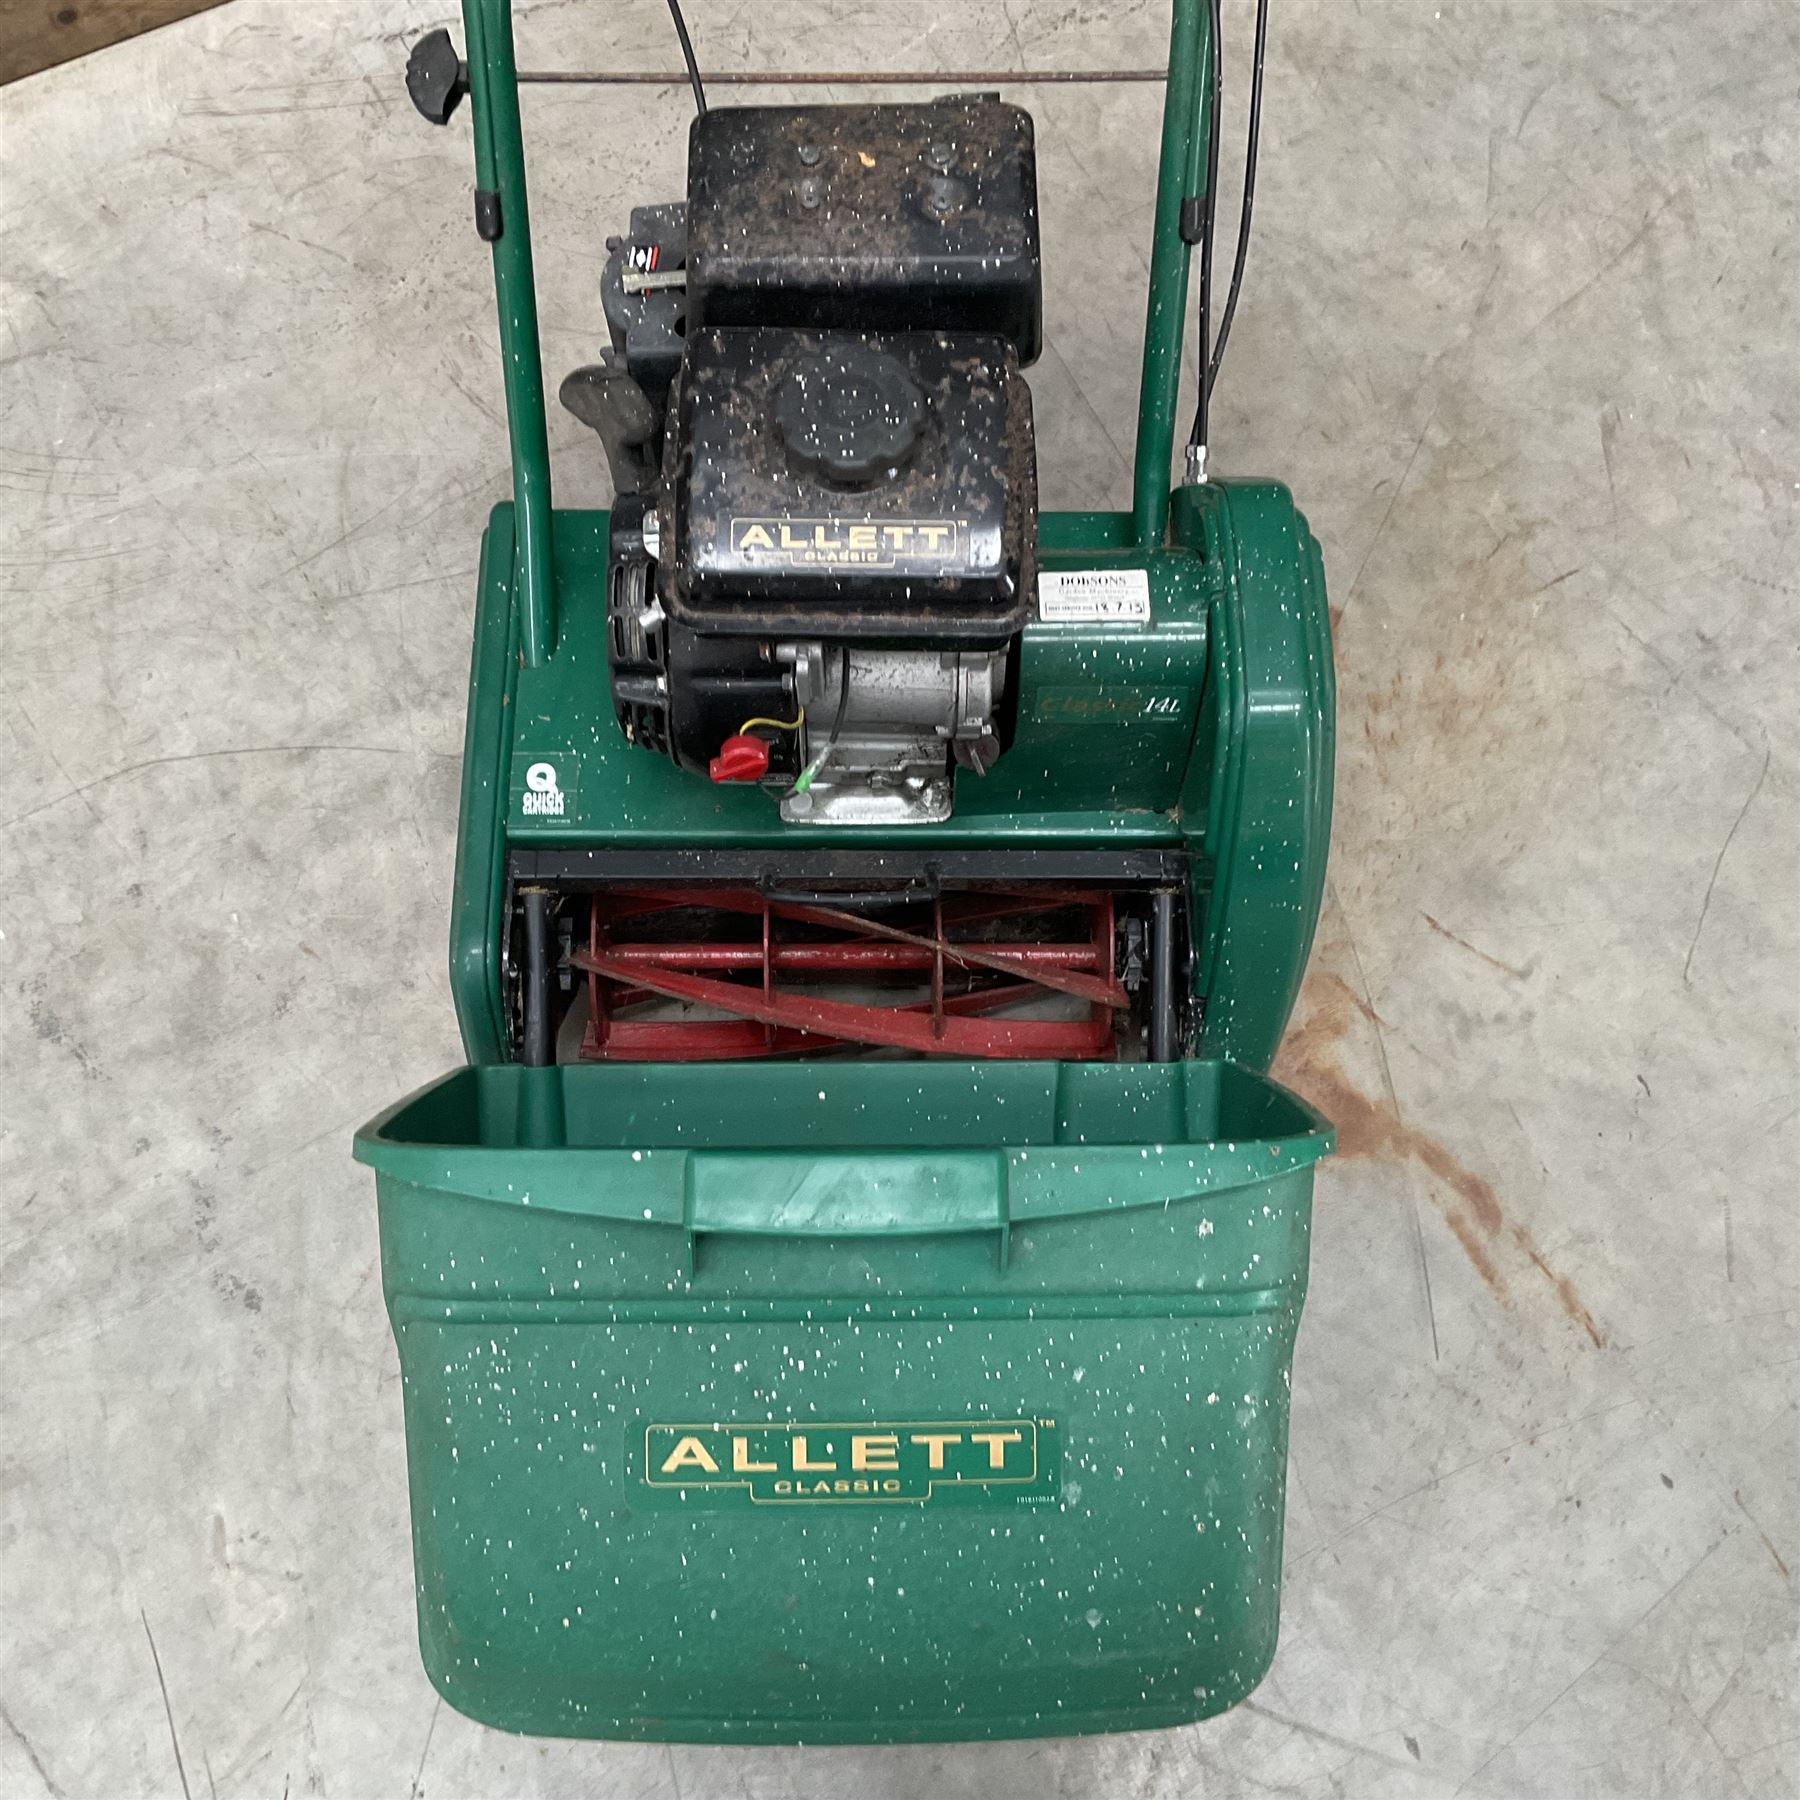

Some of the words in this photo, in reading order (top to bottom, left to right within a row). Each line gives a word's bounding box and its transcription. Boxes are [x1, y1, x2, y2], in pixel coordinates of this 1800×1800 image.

[739, 525, 949, 550] ALLETT
[804, 550, 878, 563] CLASSIC
[660, 1433, 1022, 1473] ALLETT
[774, 1480, 901, 1494] CLASSIC
